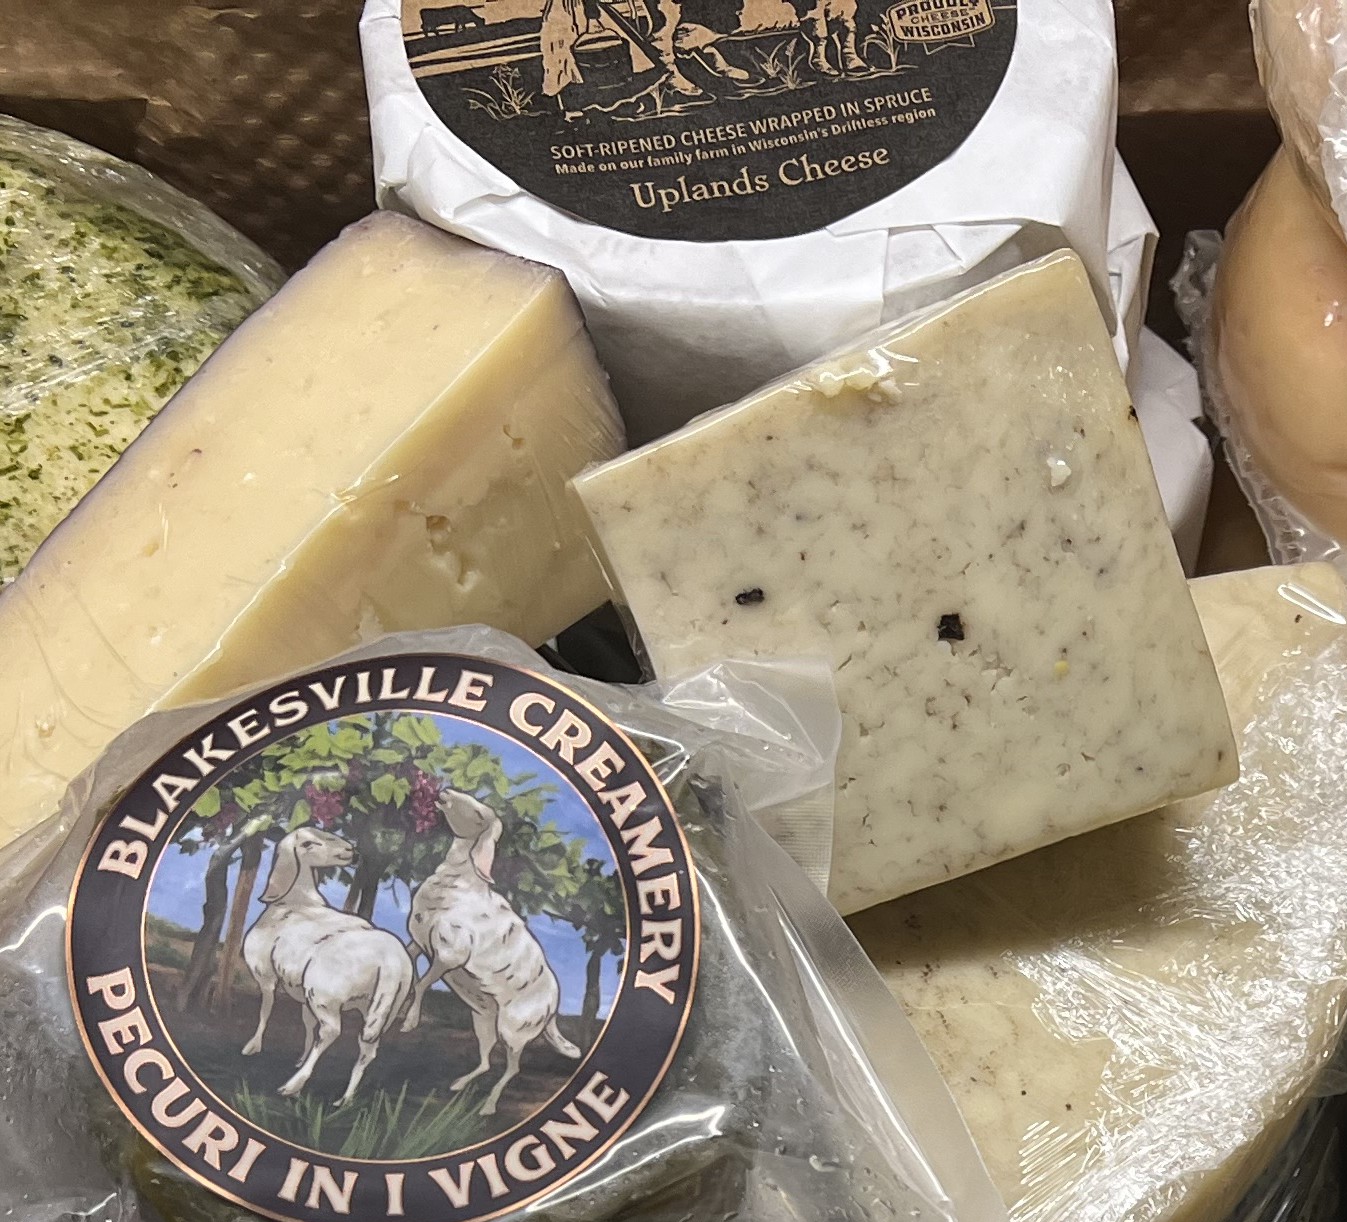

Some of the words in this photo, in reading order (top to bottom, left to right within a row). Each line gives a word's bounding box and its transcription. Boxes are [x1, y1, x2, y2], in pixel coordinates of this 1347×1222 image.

[900, 12, 986, 37] WISCONSIN
[550, 134, 676, 160] SOFT-RIPENED
[680, 122, 747, 145] CHEESE
[748, 105, 837, 134] WRAPPED
[839, 100, 861, 118] IN
[863, 87, 933, 113] SPRUCE
[554, 161, 595, 175] Made
[598, 161, 617, 172] on
[619, 158, 649, 170] our
[647, 151, 693, 168] family
[695, 147, 730, 161] farm
[731, 143, 747, 156] in
[747, 127, 829, 152] Wisconsin's
[830, 116, 889, 136] Driftless
[891, 107, 937, 124] region
[629, 165, 770, 213] Uplands
[778, 148, 890, 186] Cheese
[96, 665, 496, 881] BLAKESVILLE
[508, 691, 682, 1005] CREAMERY
[87, 965, 266, 1184] PECURI
[277, 1156, 358, 1215] IN
[385, 1172, 406, 1216] I
[427, 1070, 631, 1209] VIGNE
